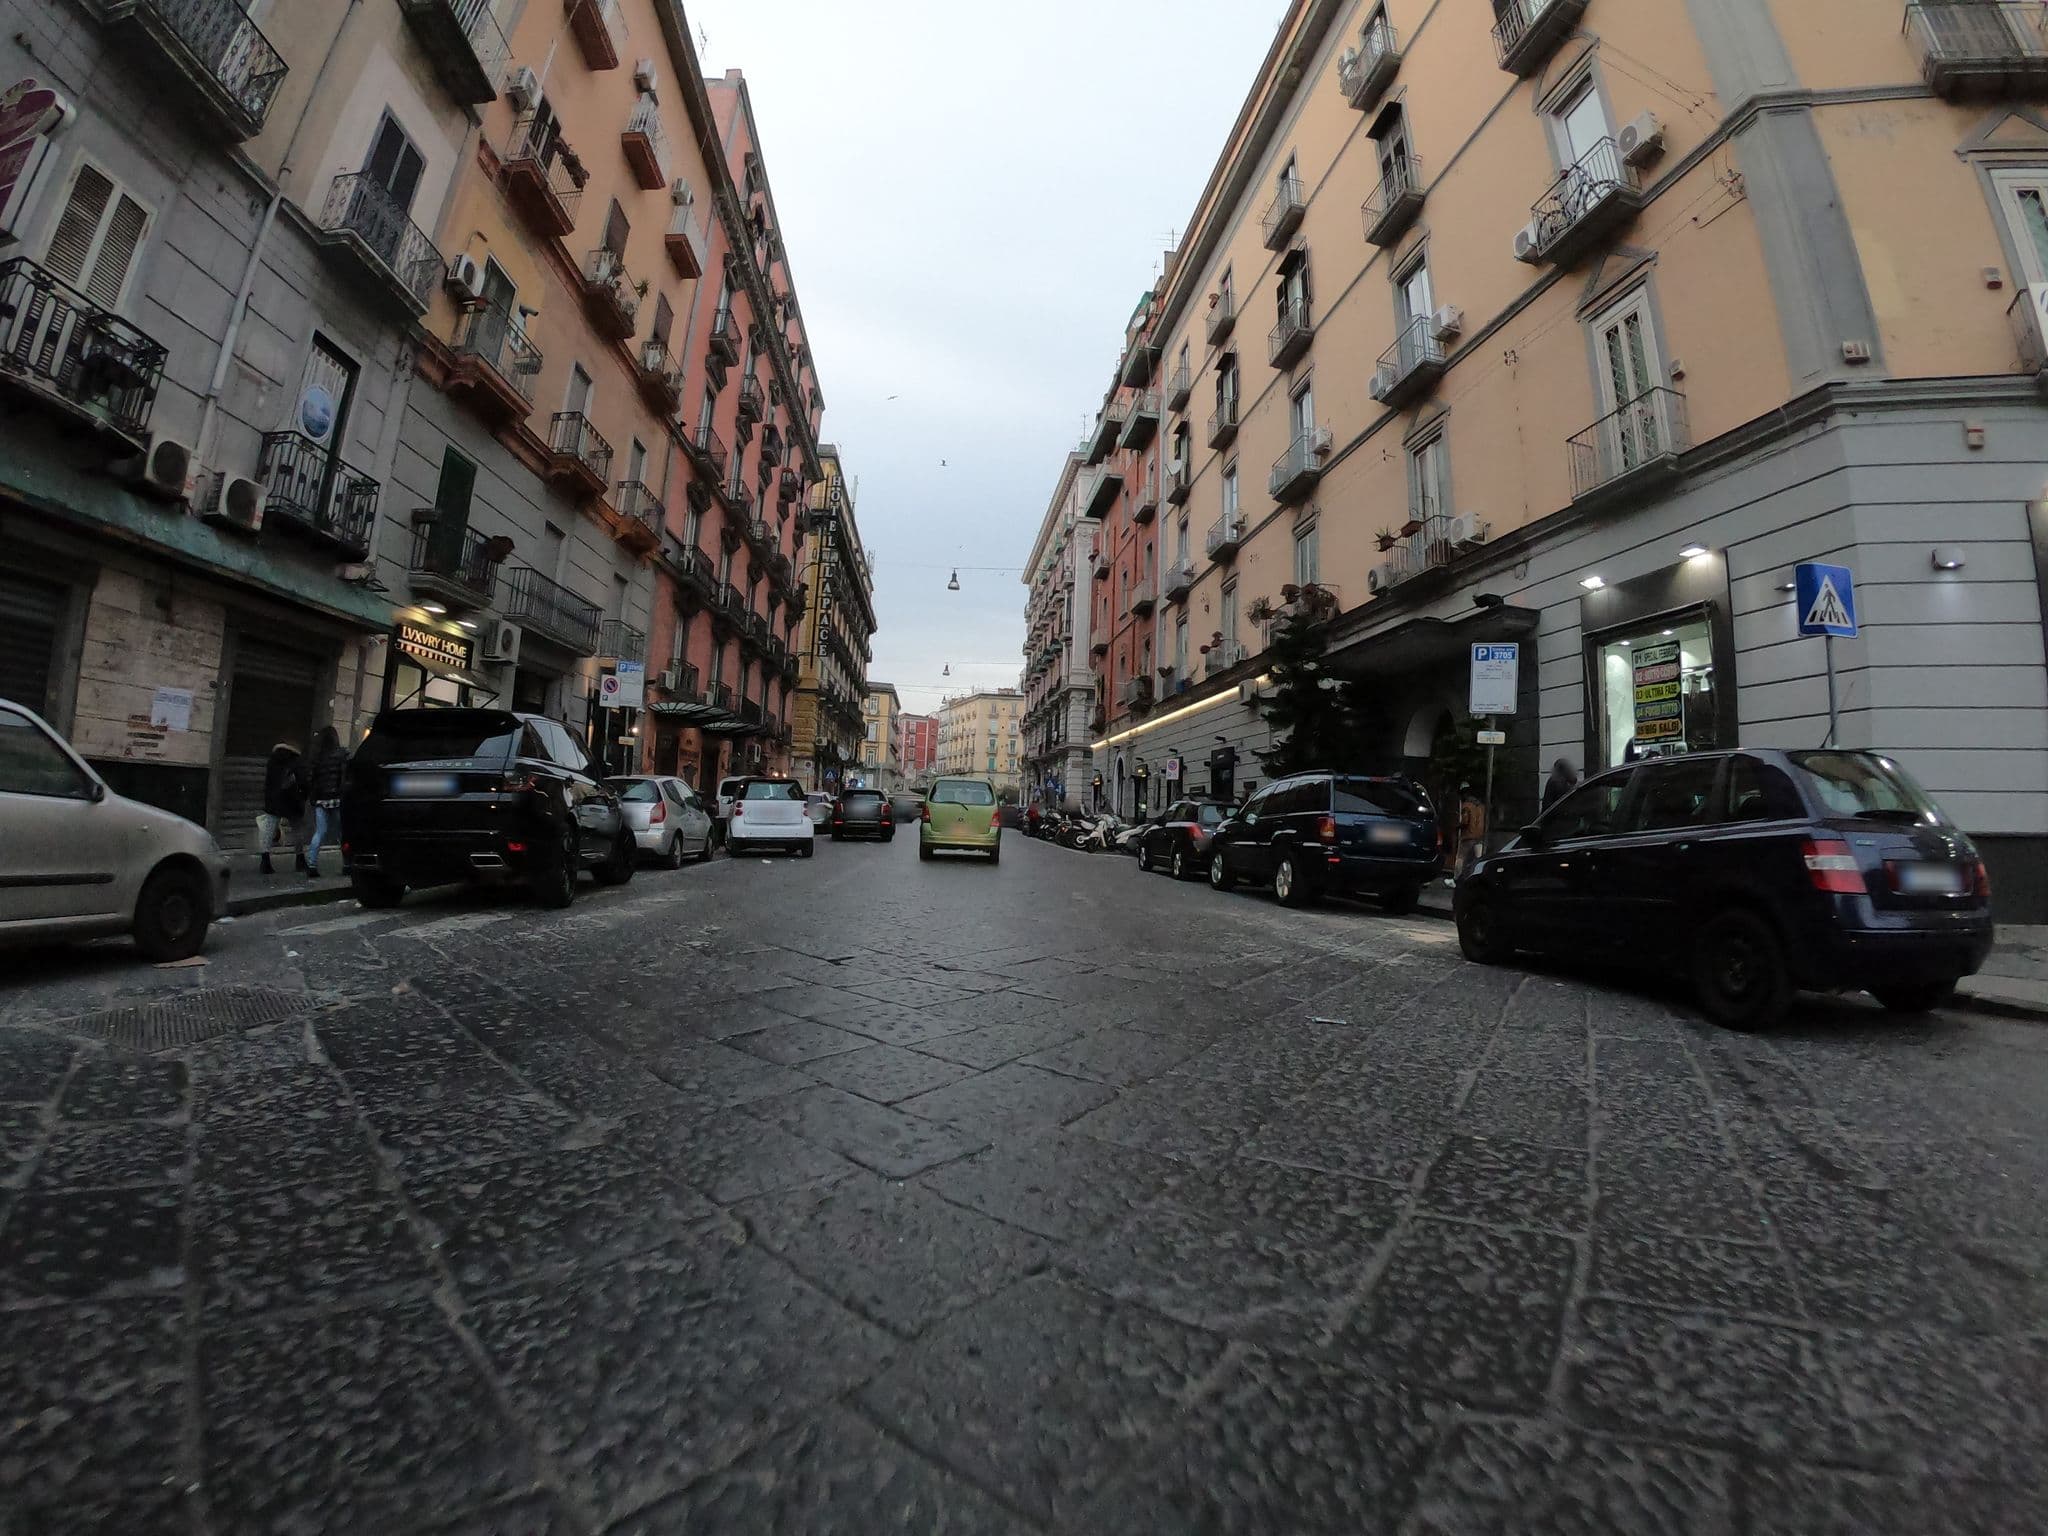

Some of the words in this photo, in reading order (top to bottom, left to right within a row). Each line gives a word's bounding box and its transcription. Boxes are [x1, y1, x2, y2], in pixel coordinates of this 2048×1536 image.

[829, 475, 841, 547] HOTEL
[402, 626, 441, 648] LVXVRY
[441, 640, 467, 658] HOME
